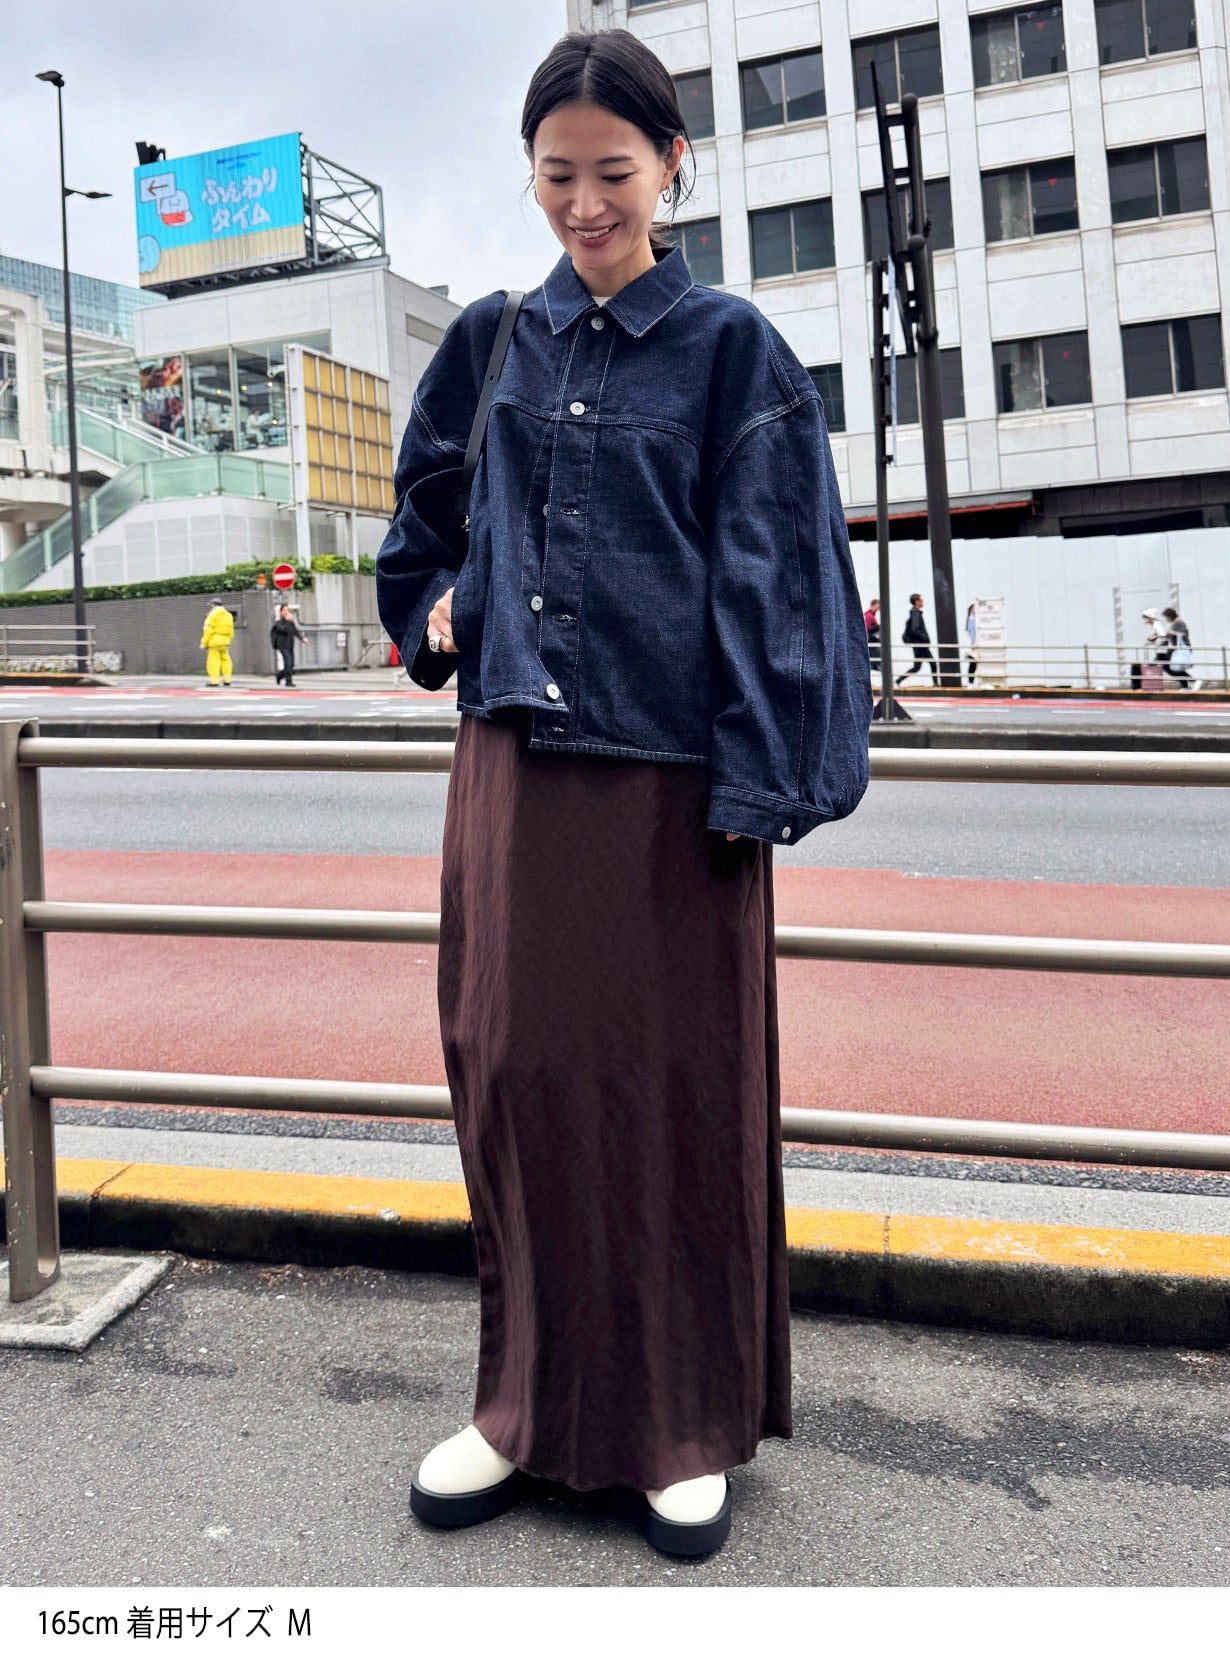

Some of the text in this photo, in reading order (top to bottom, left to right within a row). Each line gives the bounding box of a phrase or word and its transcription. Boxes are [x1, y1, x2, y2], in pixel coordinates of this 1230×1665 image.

[201, 166, 278, 205] ふんわり
[211, 203, 271, 234] タイム
